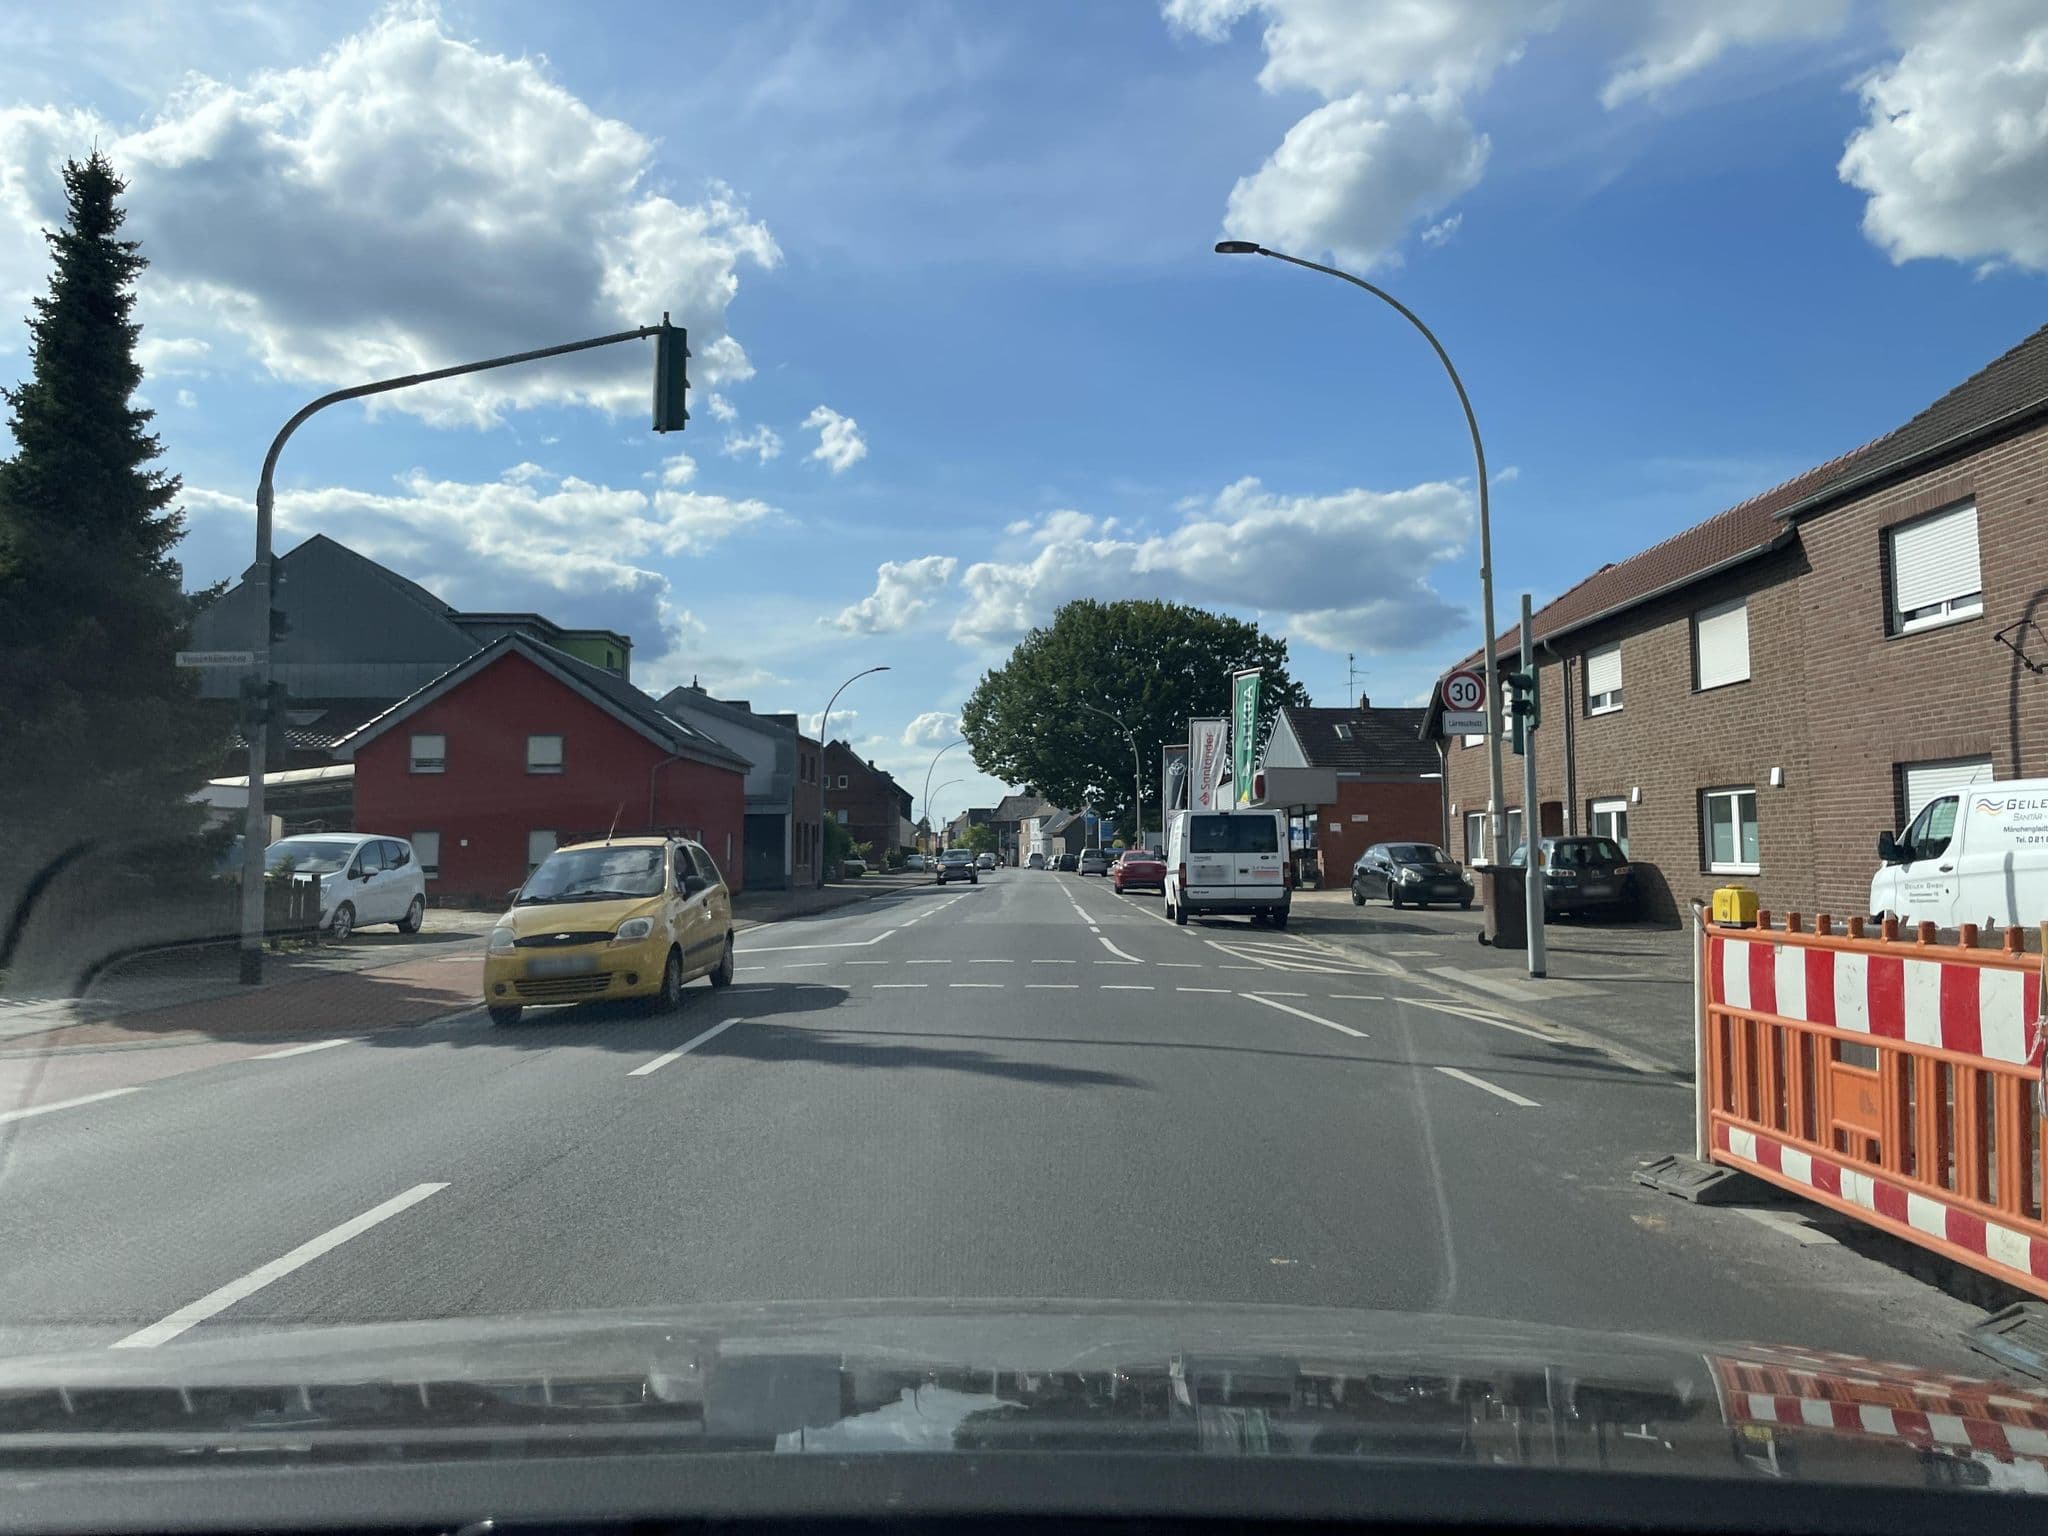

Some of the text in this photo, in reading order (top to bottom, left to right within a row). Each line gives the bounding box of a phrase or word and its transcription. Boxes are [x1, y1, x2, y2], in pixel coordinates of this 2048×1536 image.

[1452, 683, 1476, 701] 30
[1243, 684, 1253, 751] DEKRA
[1201, 732, 1213, 790] Santander
[2016, 836, 2027, 844] Tel.
